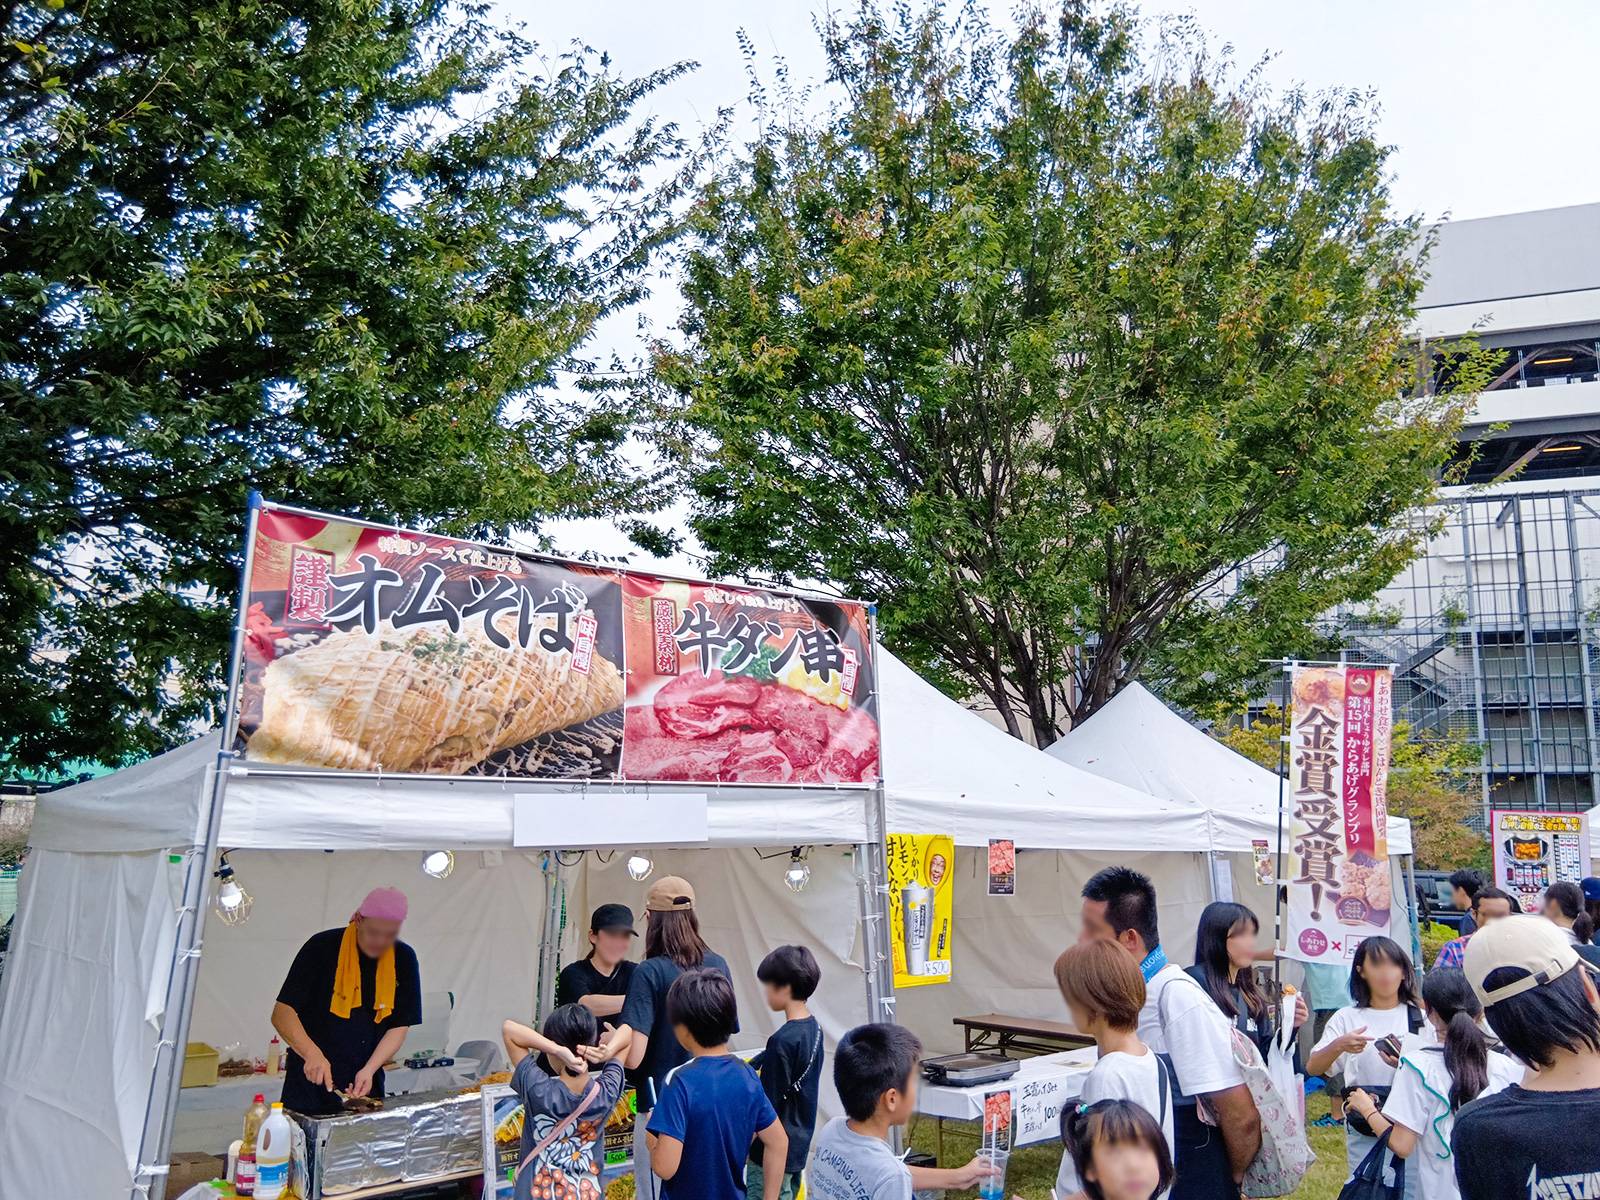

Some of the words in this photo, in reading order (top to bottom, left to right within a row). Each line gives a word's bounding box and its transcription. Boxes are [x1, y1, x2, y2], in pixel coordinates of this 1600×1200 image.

[324, 553, 587, 656] オムそば
[672, 601, 845, 684] 牛タン串
[911, 835, 920, 879] しっかり
[820, 1149, 854, 1180] CAMPING
